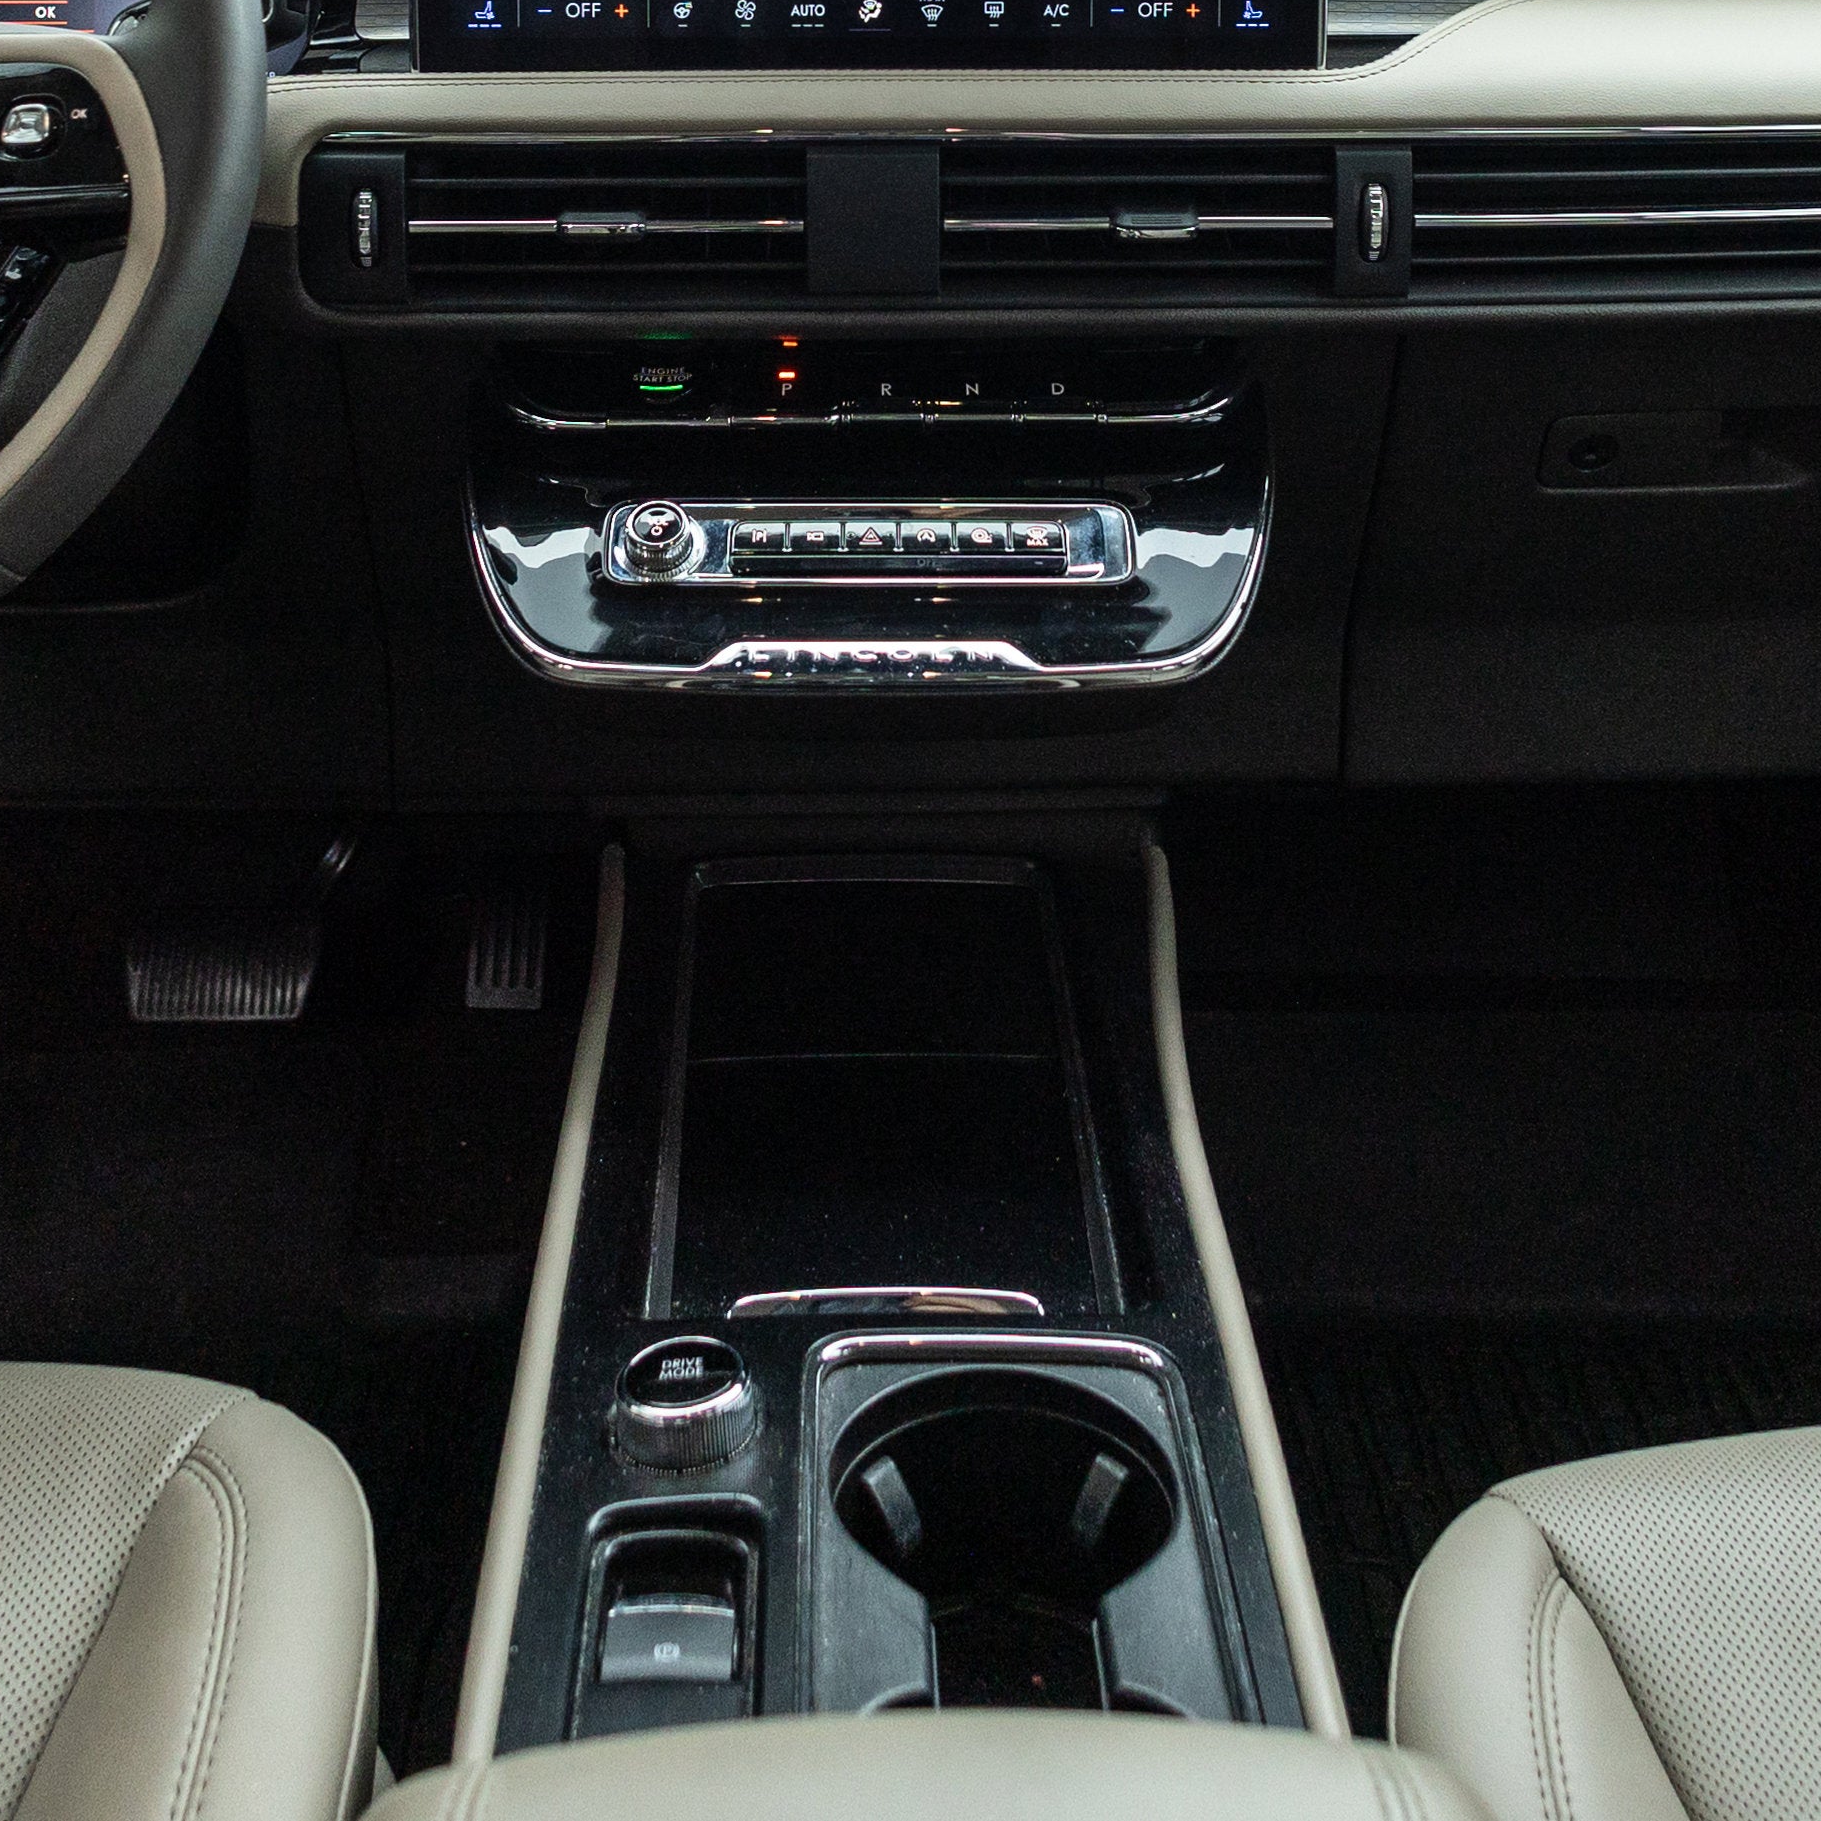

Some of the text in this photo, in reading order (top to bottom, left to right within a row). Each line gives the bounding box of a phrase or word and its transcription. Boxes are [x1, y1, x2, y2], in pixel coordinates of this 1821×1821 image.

[34, 6, 57, 19] OK
[565, 2, 602, 18] OFF
[790, 3, 826, 17] AUTO
[1043, 2, 1070, 18] A/C
[1137, 2, 1174, 18] OFF
[641, 366, 685, 375] ENGINE
[633, 372, 693, 383] START STOP
[781, 383, 793, 396] P
[880, 383, 892, 396] R
[965, 383, 979, 396] N
[1051, 383, 1064, 396] D
[1026, 538, 1049, 547] MAX
[661, 1357, 704, 1369] DRIVE
[658, 1366, 704, 1380] MODE
